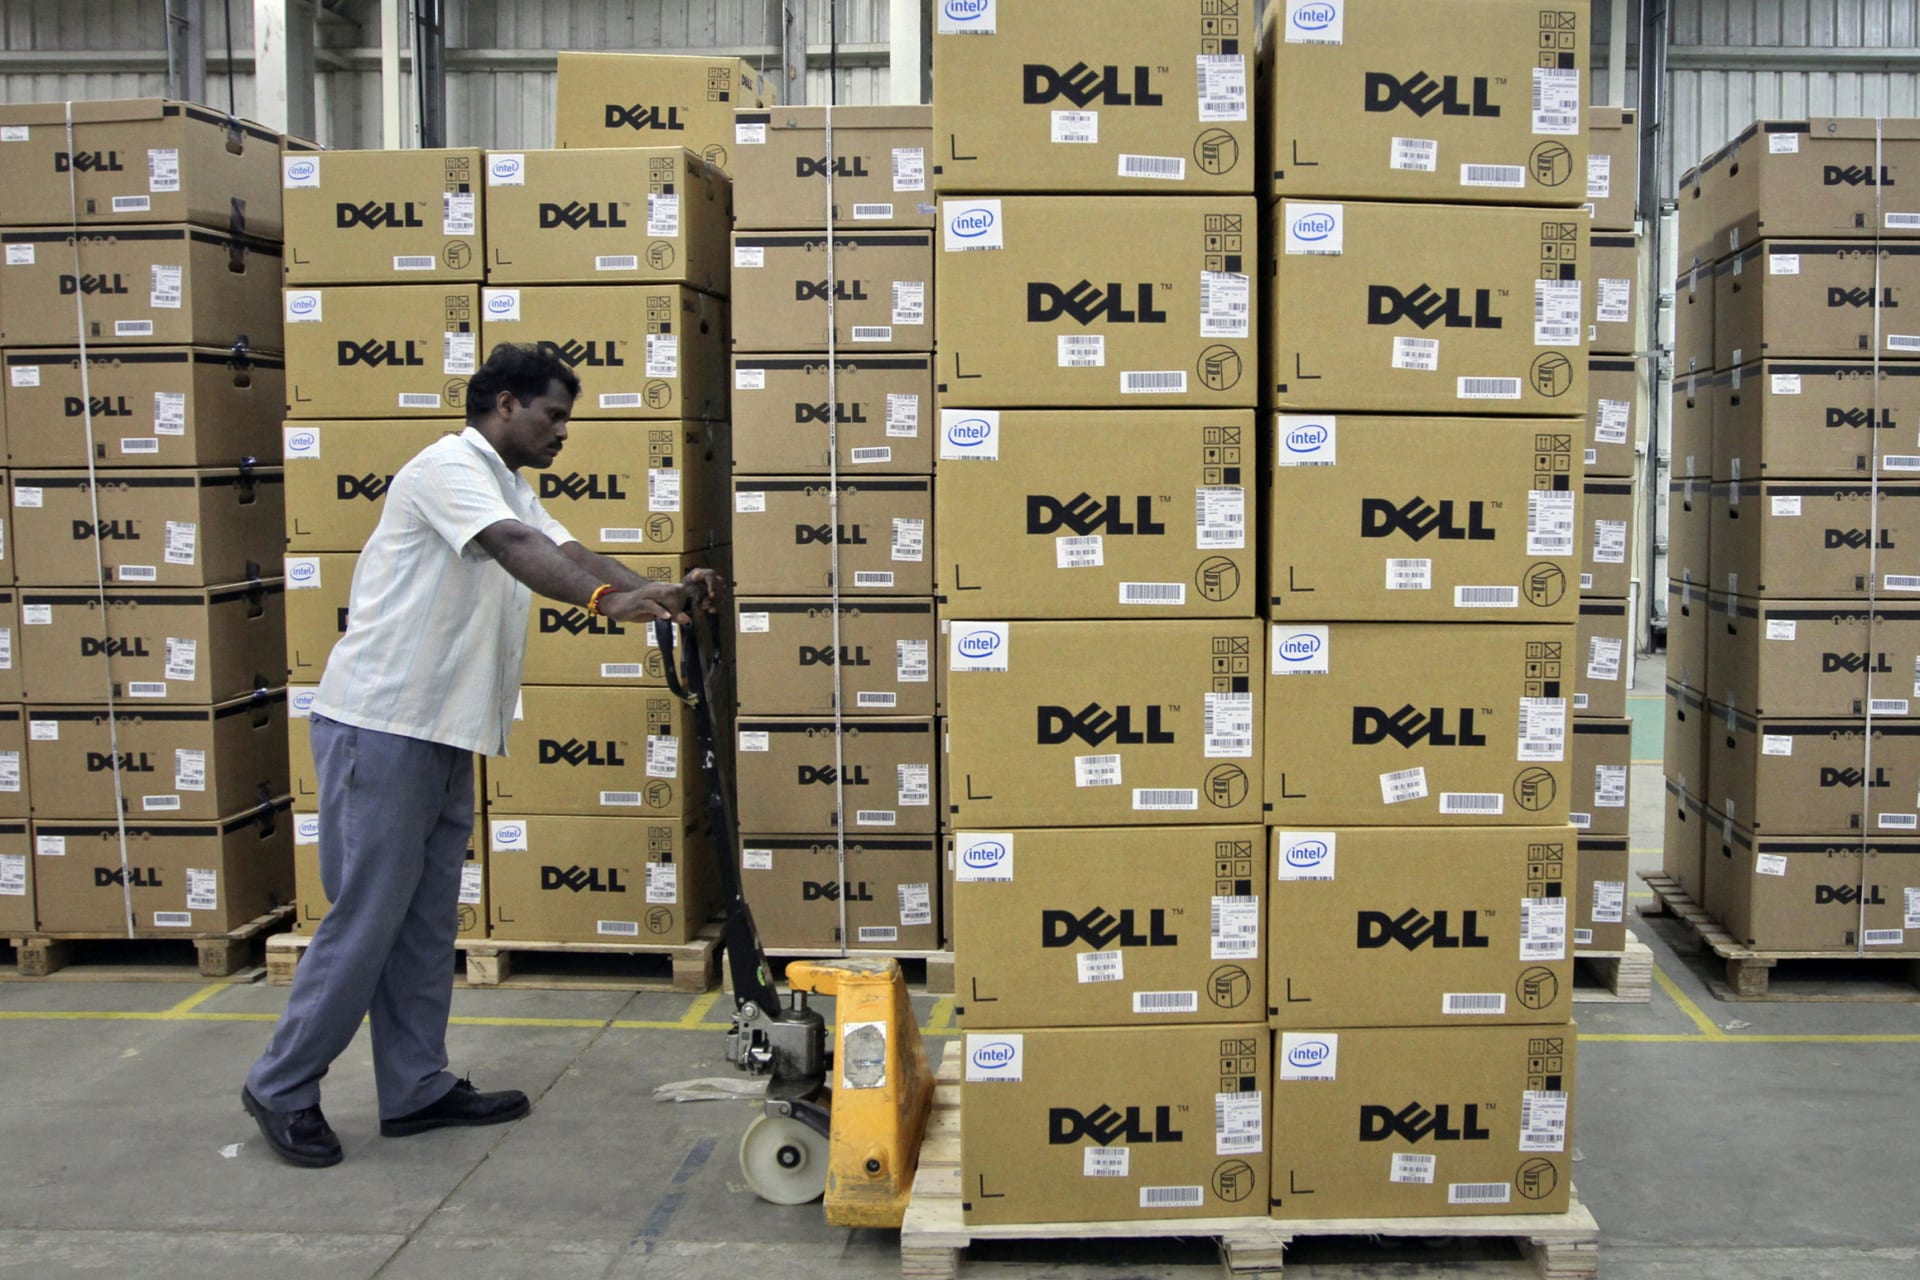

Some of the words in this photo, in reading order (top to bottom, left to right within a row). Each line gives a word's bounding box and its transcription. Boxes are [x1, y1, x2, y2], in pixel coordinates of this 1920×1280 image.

[951, 0, 981, 11] intel
[1299, 8, 1328, 21] intel
[1024, 62, 1162, 108] DELL
[1365, 71, 1500, 117] DELL
[605, 104, 684, 130] DELL
[55, 151, 123, 172] DELL
[797, 156, 868, 177] DELL
[1824, 166, 1894, 186] DELL
[337, 201, 422, 229] DELL
[540, 201, 626, 230] DELL
[957, 215, 987, 229] intel
[1299, 219, 1328, 232] intel
[60, 274, 128, 295] DELL
[796, 280, 867, 301] DELL
[1028, 280, 1166, 325] DELL
[1368, 284, 1502, 329] DELL
[1828, 286, 1898, 308] DELL
[338, 339, 423, 367] DELL
[65, 396, 132, 416] DELL
[796, 403, 866, 424] DELL
[1827, 408, 1896, 428] DELL
[954, 425, 983, 438] intel
[1291, 431, 1321, 444] intel
[540, 472, 625, 500] DELL
[1027, 492, 1164, 535] DELL
[1361, 496, 1495, 542] DELL
[73, 519, 140, 541] DELL
[796, 524, 867, 545] DELL
[1825, 529, 1894, 549] DELL
[540, 607, 624, 635] DELL
[81, 637, 148, 657] DELL
[963, 636, 993, 649] intel
[1284, 640, 1314, 653] intel
[800, 646, 870, 666] DELL
[1823, 651, 1892, 671] DELL
[1038, 703, 1174, 747] DELL
[1353, 704, 1485, 748] DELL
[87, 753, 154, 771] DELL
[539, 739, 624, 766] DELL
[799, 765, 869, 785] DELL
[1821, 768, 1890, 787] DELL
[969, 847, 998, 860] intel
[1291, 847, 1320, 859] intel
[95, 868, 162, 886] DELL
[542, 865, 625, 892] DELL
[803, 881, 873, 901] DELL
[1816, 885, 1886, 905] DELL
[1043, 907, 1177, 950] DELL
[1357, 908, 1488, 951] DELL
[979, 1048, 1008, 1061] intel
[1293, 1048, 1323, 1060] intel
[1049, 1104, 1182, 1146] DELL
[1360, 1102, 1489, 1144] DELL
